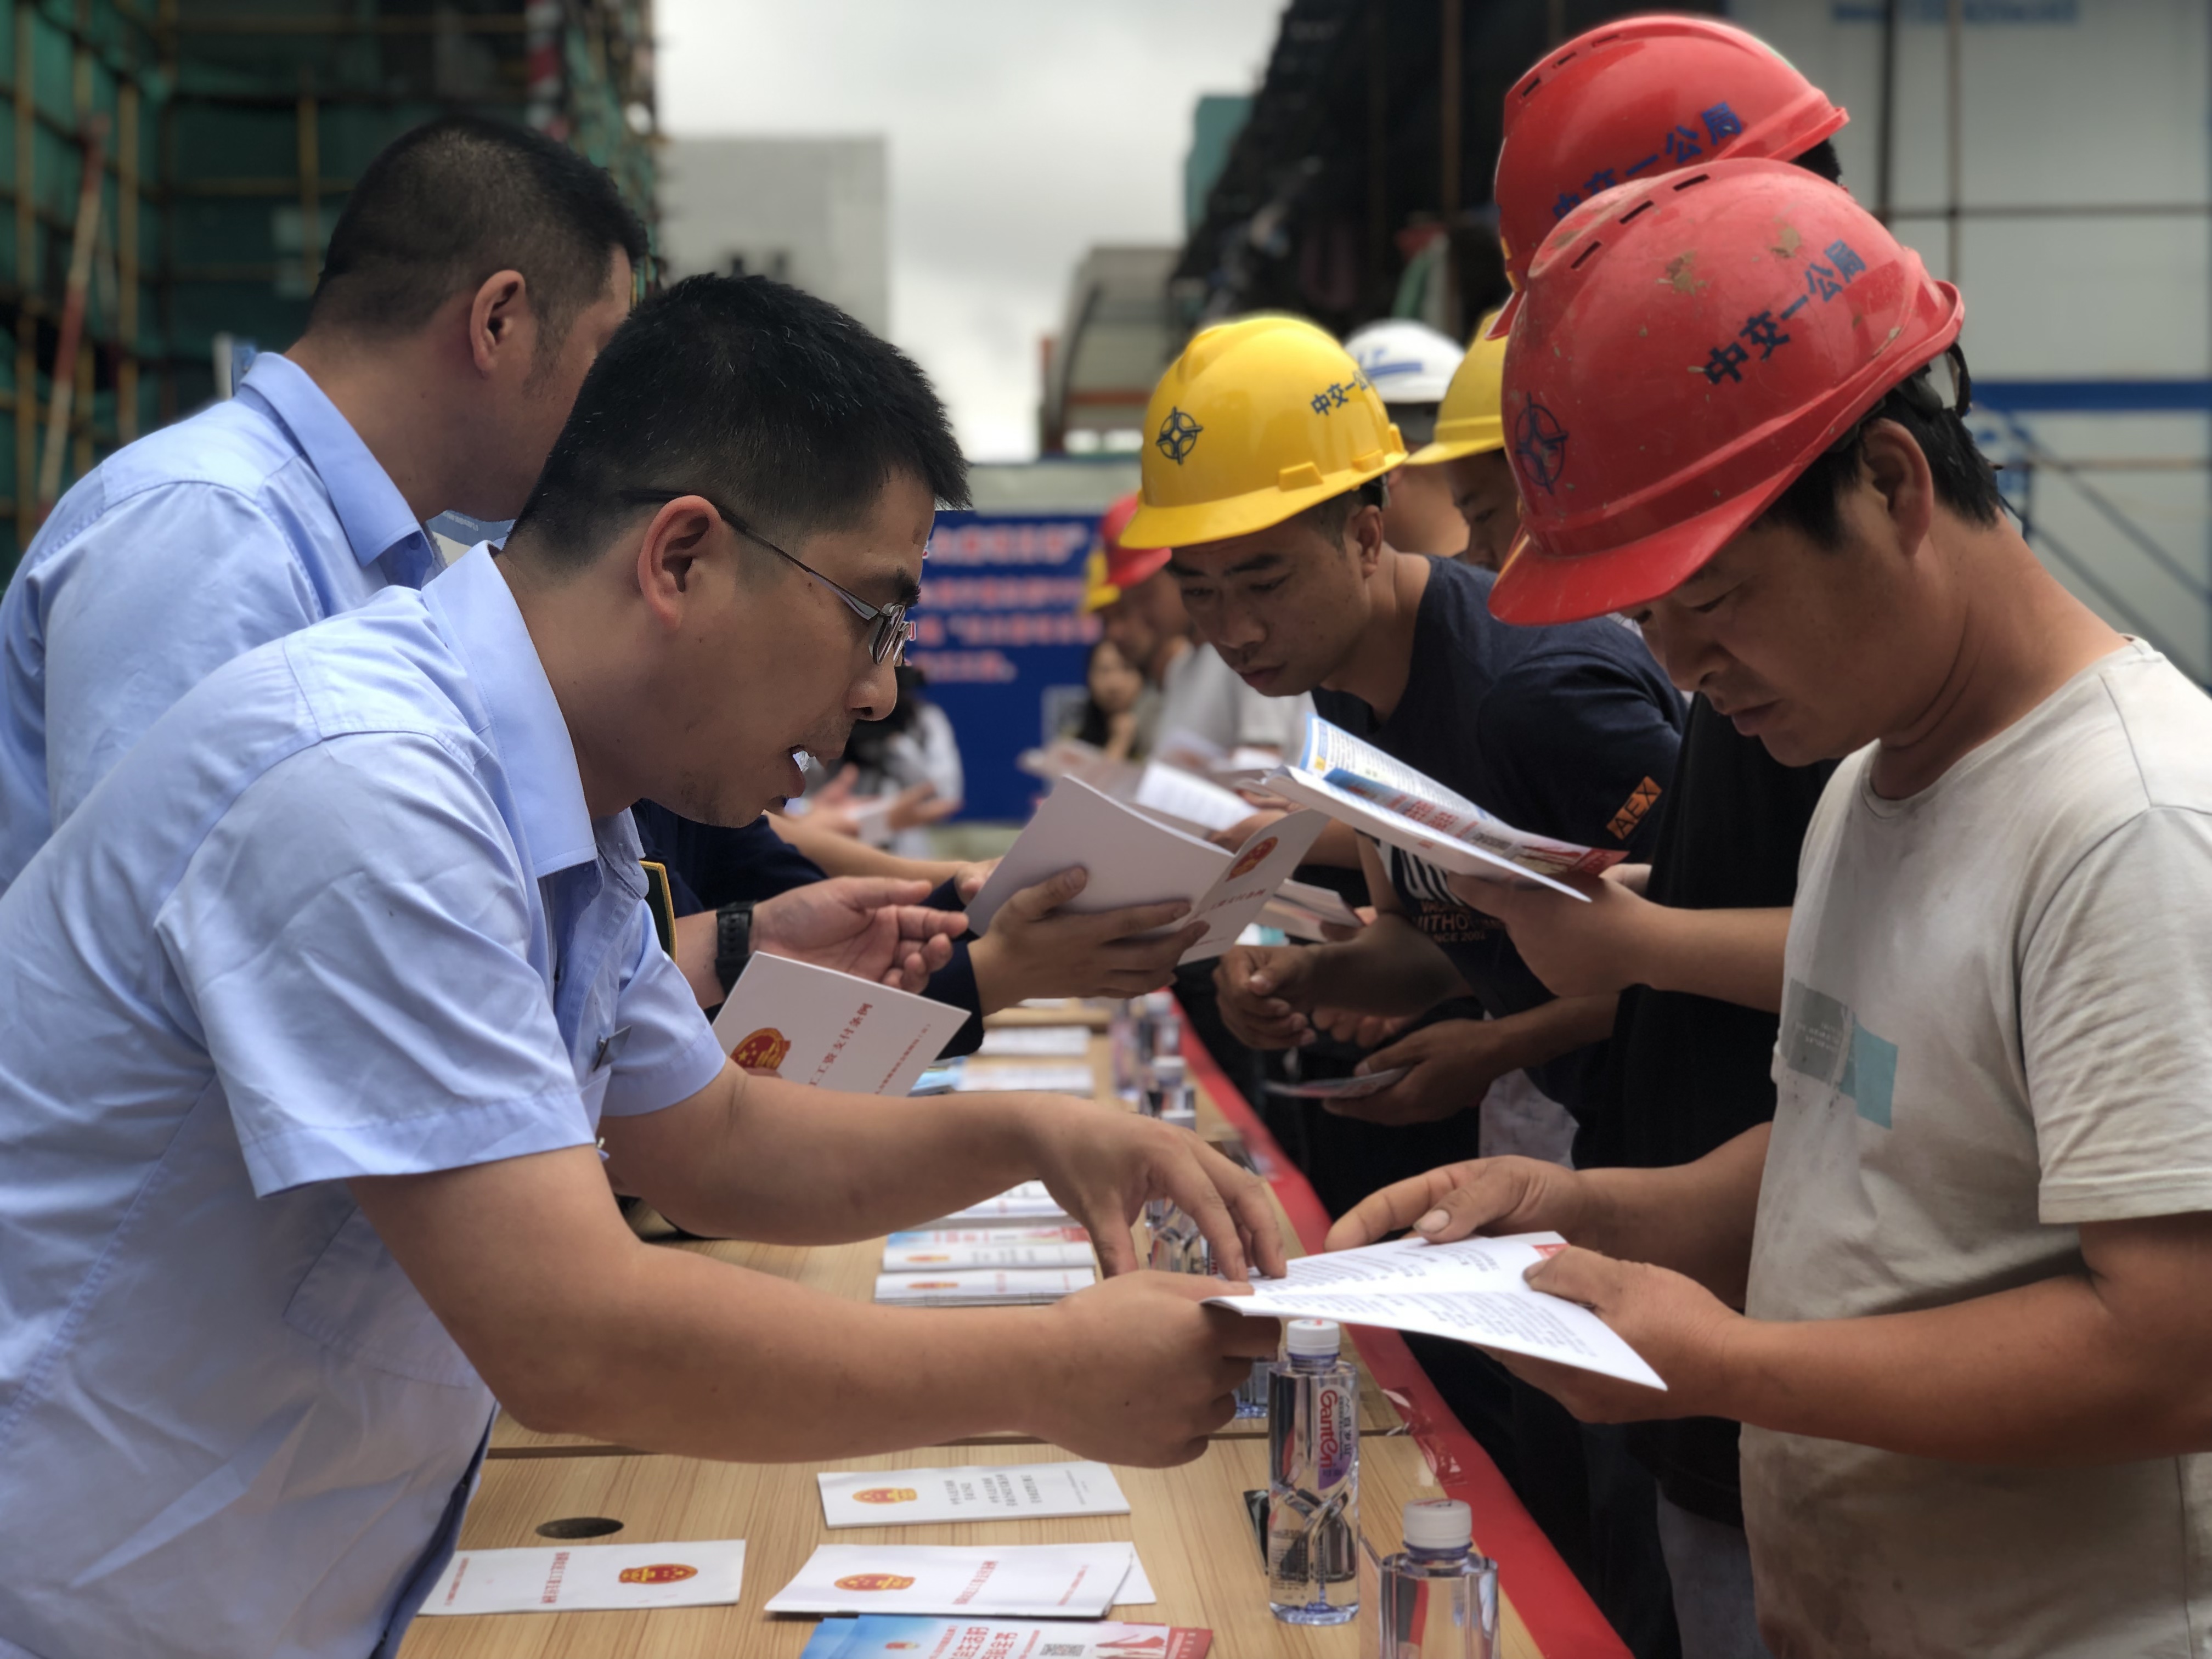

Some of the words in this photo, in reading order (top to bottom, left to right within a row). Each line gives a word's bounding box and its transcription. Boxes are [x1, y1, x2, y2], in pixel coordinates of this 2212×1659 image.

[1704, 239, 1866, 383] 中交一公局
